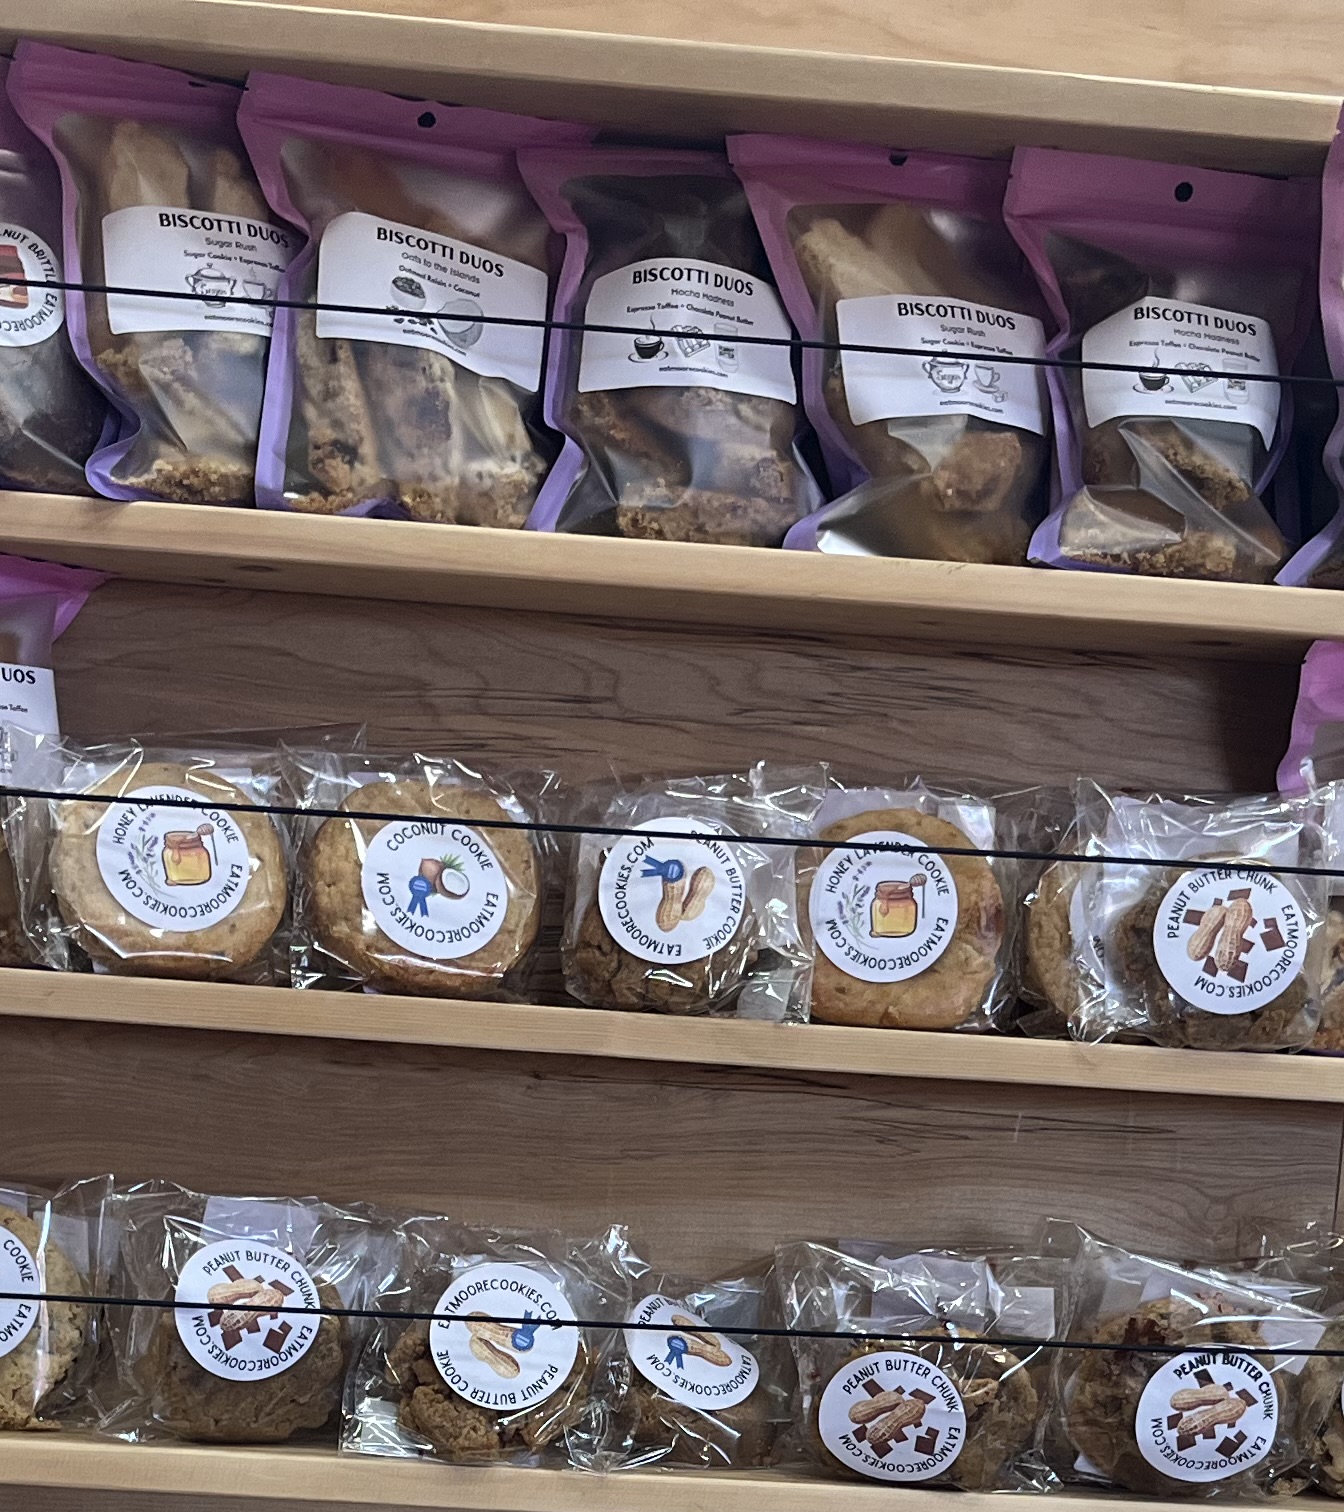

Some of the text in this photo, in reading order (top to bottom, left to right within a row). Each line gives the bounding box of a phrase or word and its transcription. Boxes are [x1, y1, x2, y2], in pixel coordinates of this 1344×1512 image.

[159, 213, 290, 248] BISCOTTI DUOS
[377, 227, 505, 277] BISCOTTI DUOS
[632, 267, 754, 296] BISCOTTI DUOS
[897, 302, 1015, 330] BISCOTTI DUOS
[1134, 306, 1256, 336] BISCOTTI DUOS
[113, 807, 138, 845] HONEY
[386, 822, 494, 871] COCONUT COOKIE
[118, 863, 243, 918] EATMOORECOOKIES.COM
[825, 854, 950, 896] HONEY COOKIE
[377, 872, 500, 943] EATMOORECOOKIES.COM
[702, 868, 742, 950] BUTTER COOKIE
[825, 917, 949, 970] EATMOORECOOKIES.COM
[1194, 903, 1296, 999] EATMOORECOOKIES.COM
[3, 1239, 35, 1283] COOKIE
[202, 1251, 291, 1276] PEANUT BUTTER
[192, 1314, 314, 1372] EATMOORECOOKIES.COM
[437, 1348, 470, 1394] COOKIE
[843, 1358, 961, 1413] PEANUT BUTTER CHUNK
[1259, 1383, 1274, 1420] CHUNK
[838, 1426, 961, 1473] EATMOORECOOKIES.COM
